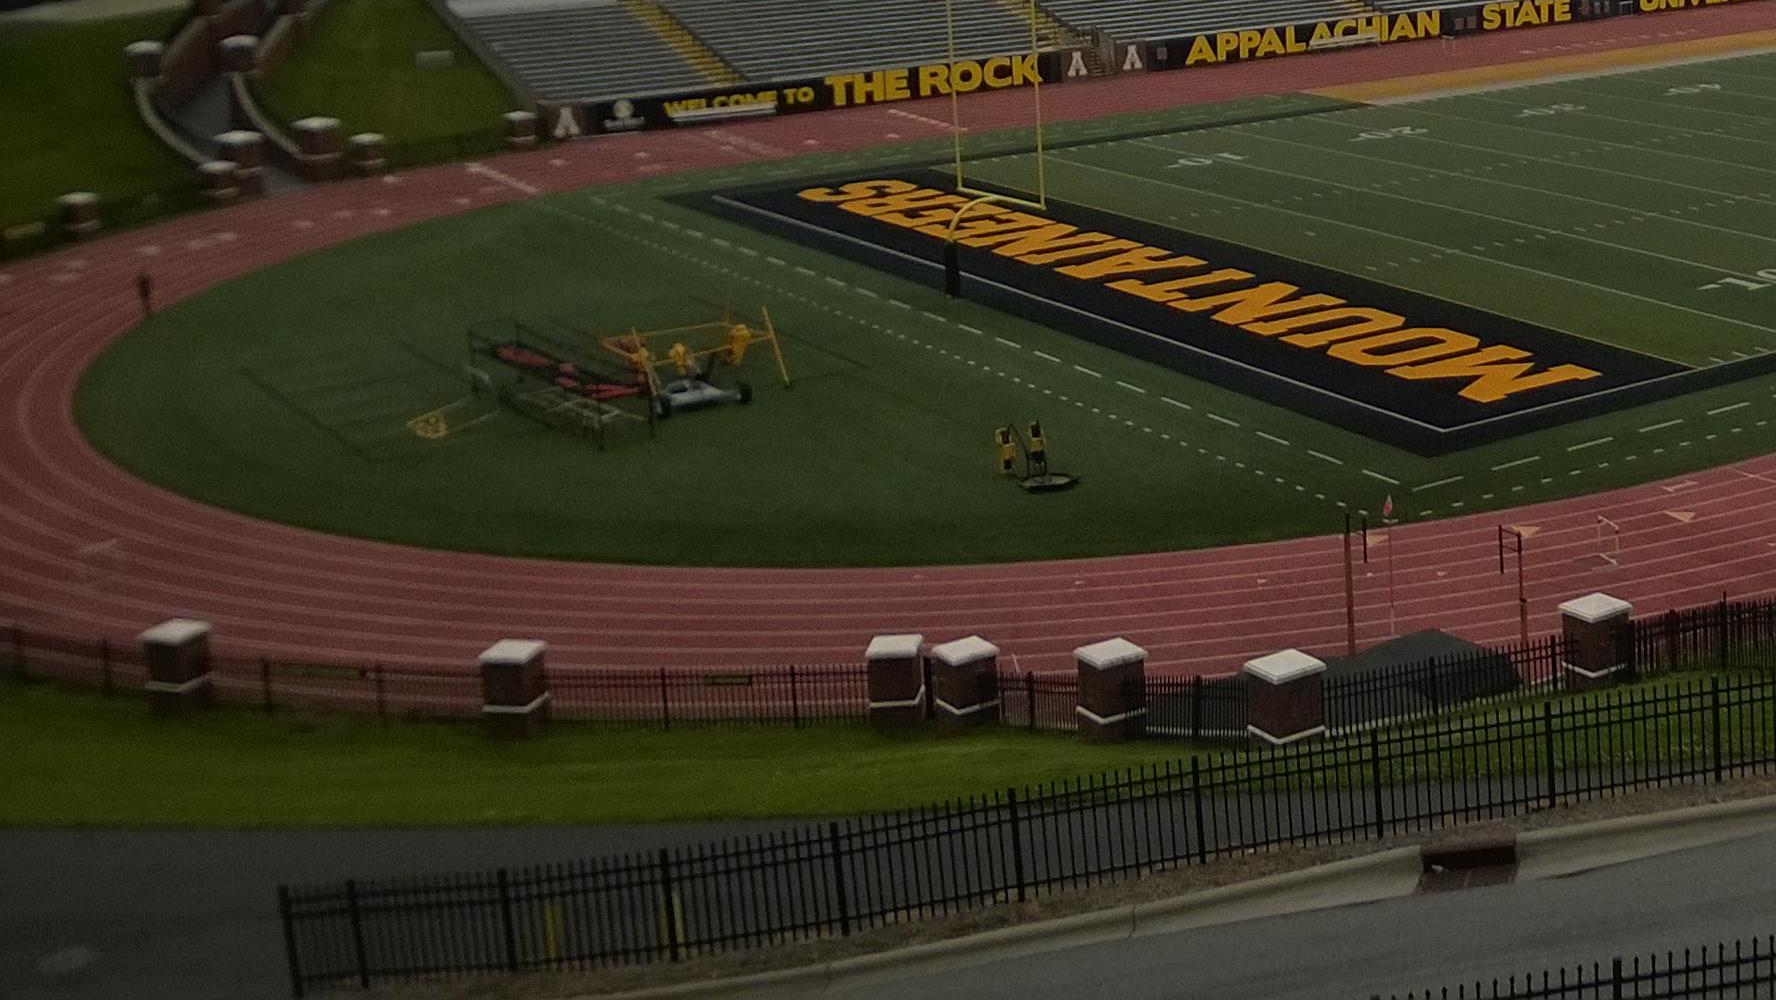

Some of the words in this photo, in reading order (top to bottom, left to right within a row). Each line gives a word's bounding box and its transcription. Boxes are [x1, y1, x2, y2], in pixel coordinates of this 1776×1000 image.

[1067, 50, 1088, 78] A
[1122, 44, 1143, 71] A
[1186, 10, 1440, 65] APPALACHIAN
[663, 90, 778, 117] WELCOME
[784, 86, 815, 105] TO
[824, 68, 910, 107] THE
[918, 53, 1043, 97] ROCK
[797, 180, 1603, 403] MOUNTAINEERS
